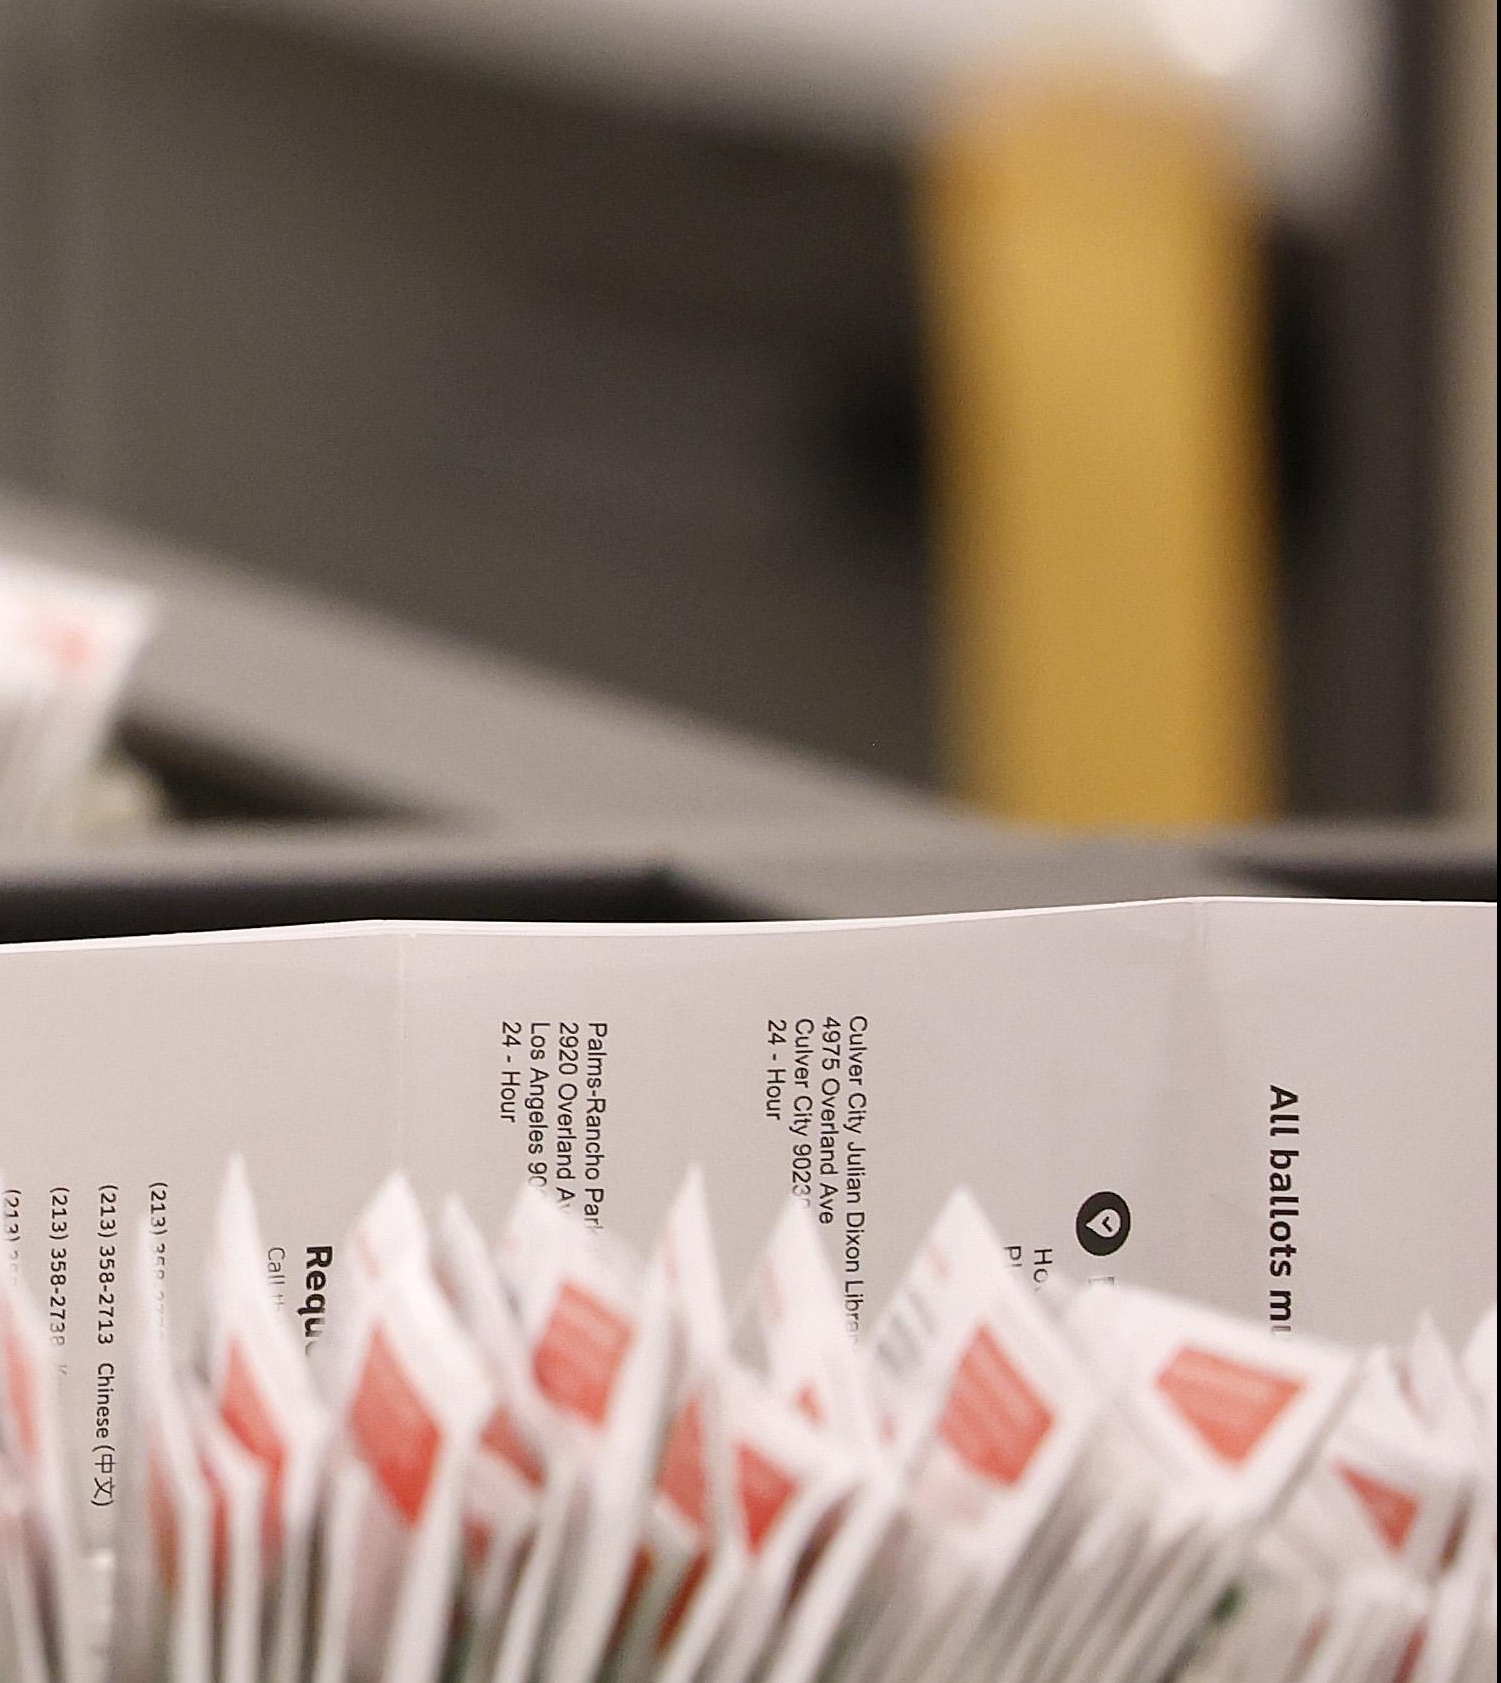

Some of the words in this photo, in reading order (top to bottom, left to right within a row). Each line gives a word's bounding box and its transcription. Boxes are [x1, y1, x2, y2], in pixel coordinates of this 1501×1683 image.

[501, 1021, 521, 1047] 24
[529, 1022, 549, 1061] Los
[556, 1022, 577, 1075] 2920
[766, 1019, 785, 1046] 24
[793, 1018, 813, 1088] Culver
[820, 1016, 839, 1071] 4975
[845, 1016, 867, 1086] Culver
[499, 1071, 520, 1123] Hour
[524, 1067, 548, 1155] Angeles
[582, 1022, 607, 1181] Palms-Rancho
[764, 1069, 784, 1121] Hour
[788, 1095, 812, 1137] City
[842, 1092, 866, 1133] City
[1268, 1084, 1298, 1136] All
[554, 1082, 576, 1180] Overland
[818, 1078, 839, 1176] Overland
[845, 1141, 867, 1204] Julian
[2, 1189, 21, 1243] (213)
[48, 1187, 69, 1240] (213)
[97, 1184, 117, 1238] (213)
[148, 1182, 168, 1235] (213)
[818, 1182, 837, 1224] Ave
[1268, 1149, 1299, 1277] ballots
[266, 1246, 286, 1286] Call
[843, 1212, 864, 1273] Dixon
[97, 1245, 114, 1345] 358-2713
[1032, 1248, 1052, 1292] Ho
[95, 1363, 114, 1439] Chinese
[90, 1444, 116, 1507] (中文)
